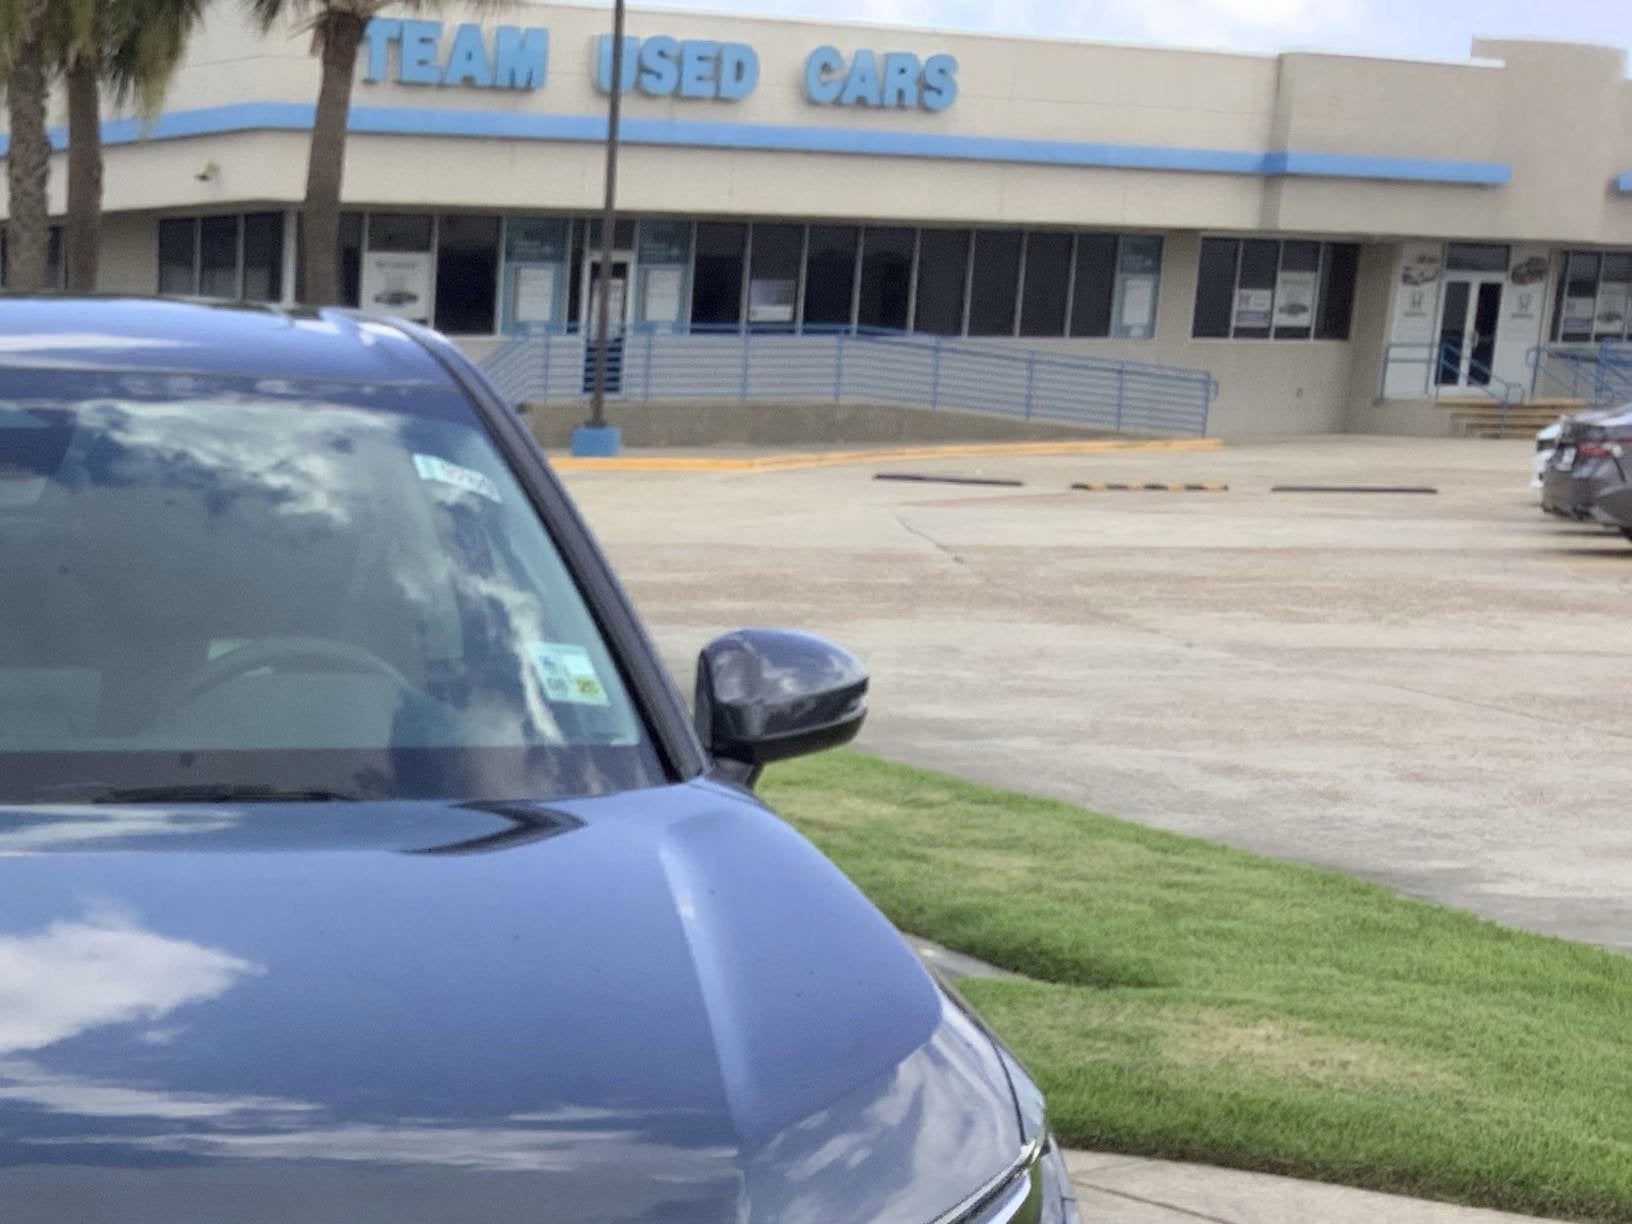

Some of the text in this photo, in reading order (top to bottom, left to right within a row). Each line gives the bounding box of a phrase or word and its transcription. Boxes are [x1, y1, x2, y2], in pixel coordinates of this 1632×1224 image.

[364, 16, 959, 112] TEAM USED CARS
